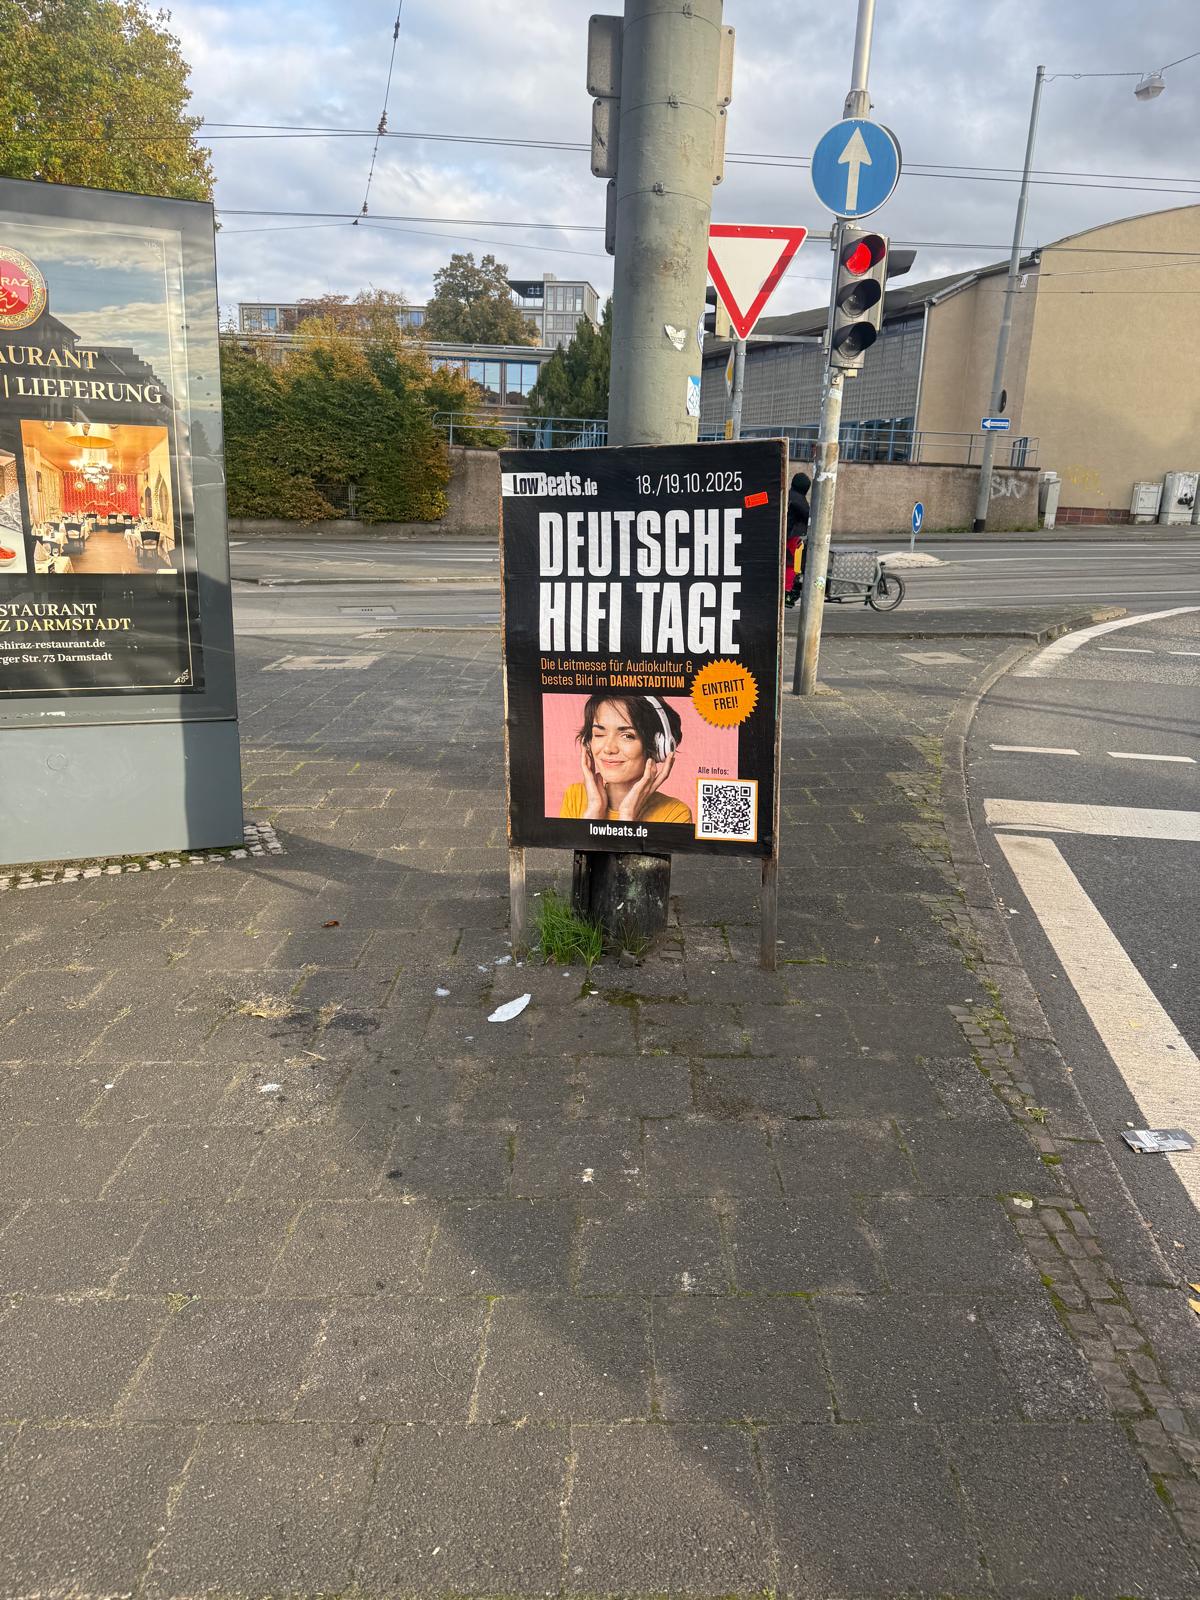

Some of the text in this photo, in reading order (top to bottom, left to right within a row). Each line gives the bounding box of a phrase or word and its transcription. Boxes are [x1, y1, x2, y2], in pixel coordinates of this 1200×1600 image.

[16, 376, 163, 403] LIEFERUNG
[513, 471, 743, 497] LowBeats.de 18./19.10.2025
[538, 508, 743, 577] DEUTSCHE
[15, 618, 131, 632] DARMSTADT
[539, 582, 742, 655] HIFI TAGE
[22, 654, 41, 663] Str.
[43, 654, 55, 663] 73
[57, 652, 113, 662] Darmstadt
[541, 657, 693, 673] Die Leitmesse für Audiokultur &
[541, 672, 685, 689] bestes Bild im DARMSTADTIUM
[701, 678, 746, 696] EINTRITT
[713, 697, 739, 711] FREI!
[698, 766, 729, 776] Alle Infos:
[589, 823, 648, 838] lowbeats.de
